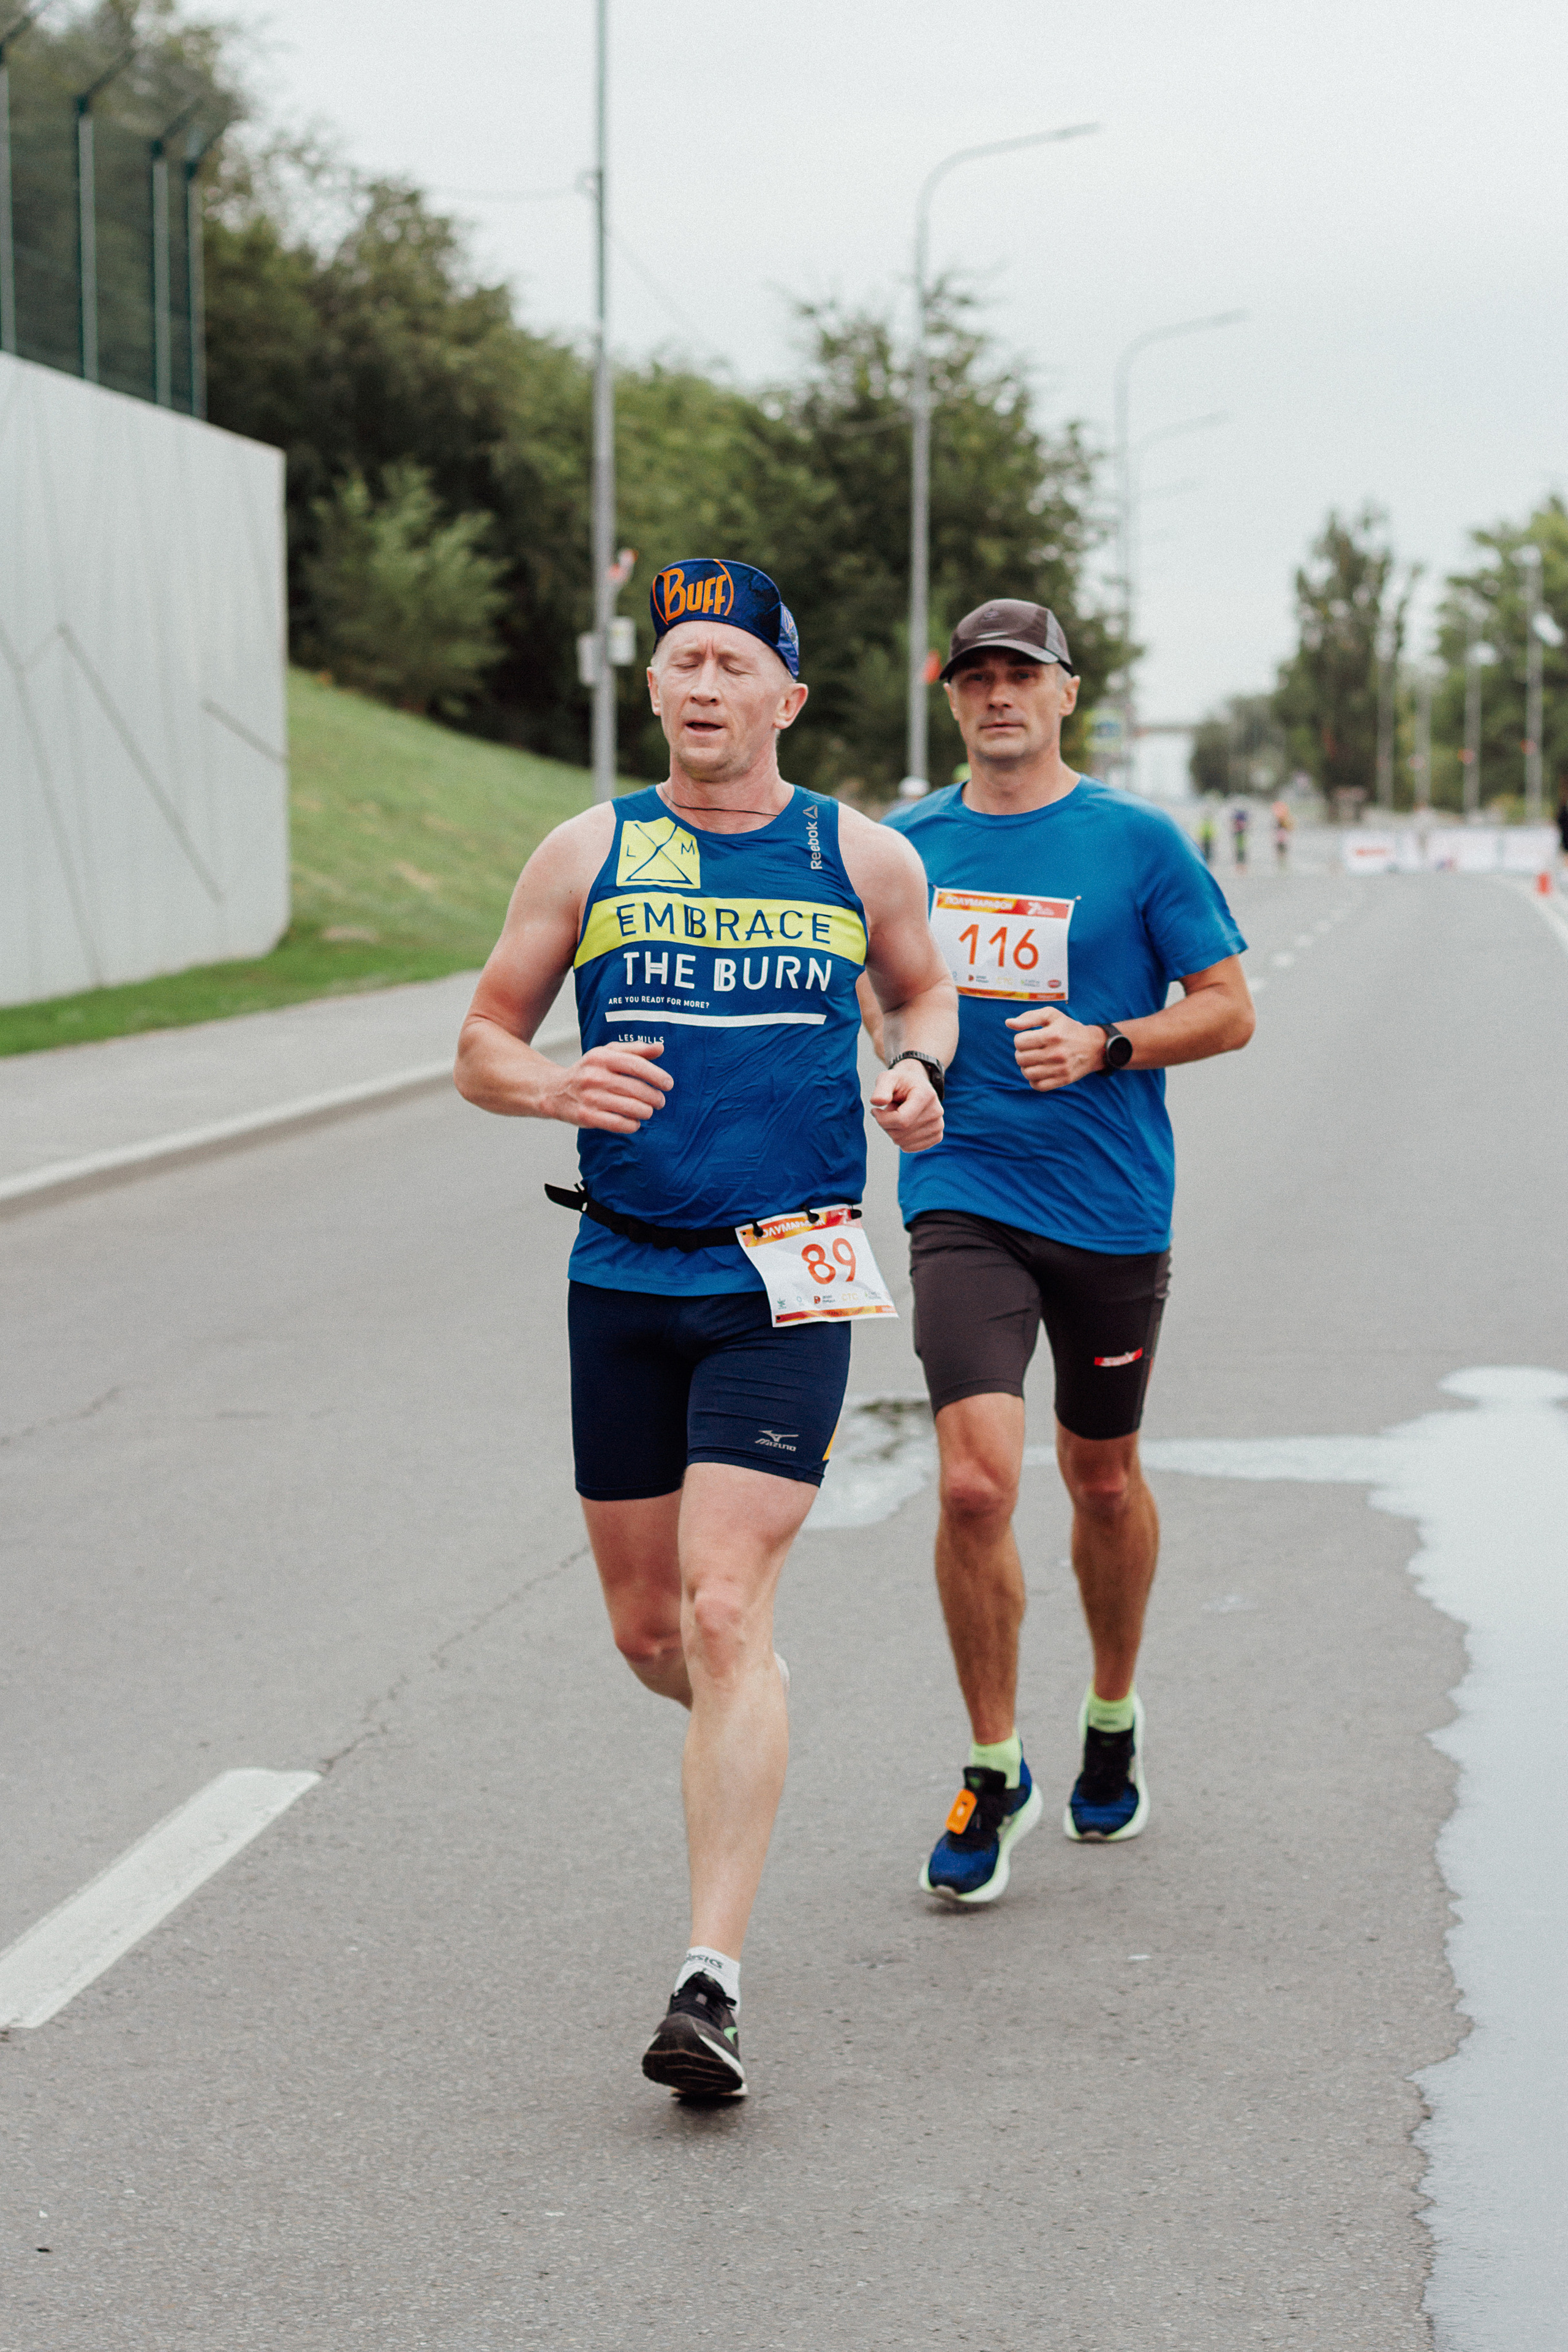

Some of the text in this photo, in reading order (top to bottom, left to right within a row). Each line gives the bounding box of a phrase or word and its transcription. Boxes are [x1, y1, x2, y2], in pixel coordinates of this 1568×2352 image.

[805, 821, 823, 870] Reebok
[616, 902, 832, 944] EMBRACE
[958, 924, 1039, 970] 116
[623, 951, 832, 992] THE BURN
[666, 997, 682, 1006] FOR
[684, 1000, 710, 1009] MORE?
[638, 1035, 665, 1044] MILLS
[801, 1238, 856, 1285] 89
